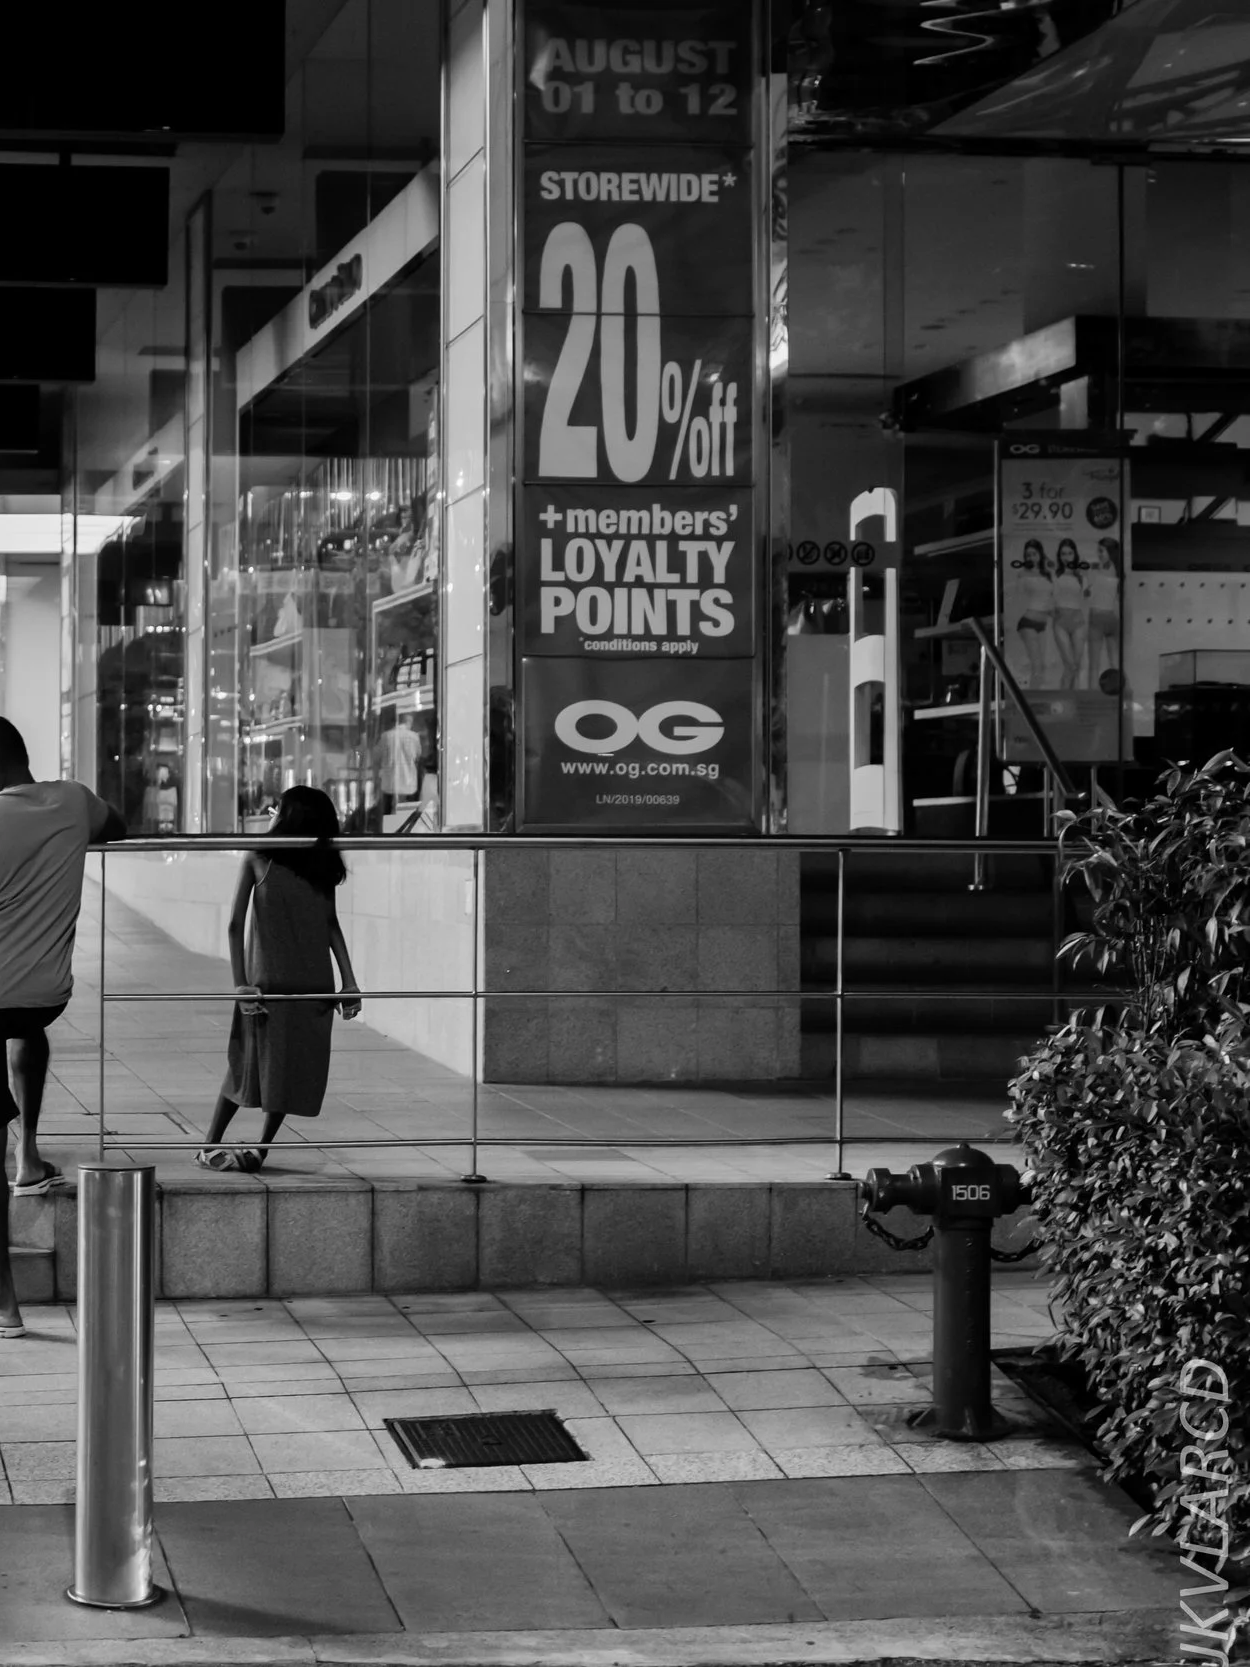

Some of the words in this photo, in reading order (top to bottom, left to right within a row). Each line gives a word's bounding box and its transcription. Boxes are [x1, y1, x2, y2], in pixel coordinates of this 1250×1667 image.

[547, 37, 737, 75] AUGUST
[542, 80, 594, 114] 01
[615, 82, 664, 115] to
[678, 83, 738, 115] 12
[1010, 444, 1040, 454] OG
[1022, 481, 1034, 499] 3
[1040, 481, 1065, 499] for
[1012, 502, 1073, 520] $29.90
[540, 538, 736, 584] LOYALTY
[540, 586, 735, 637] POINTS
[661, 640, 699, 654] apply
[554, 699, 725, 756] OG
[560, 762, 720, 779] www.og.com.sg
[596, 794, 680, 805] LN/2019/00639
[951, 1184, 990, 1201] 1506
